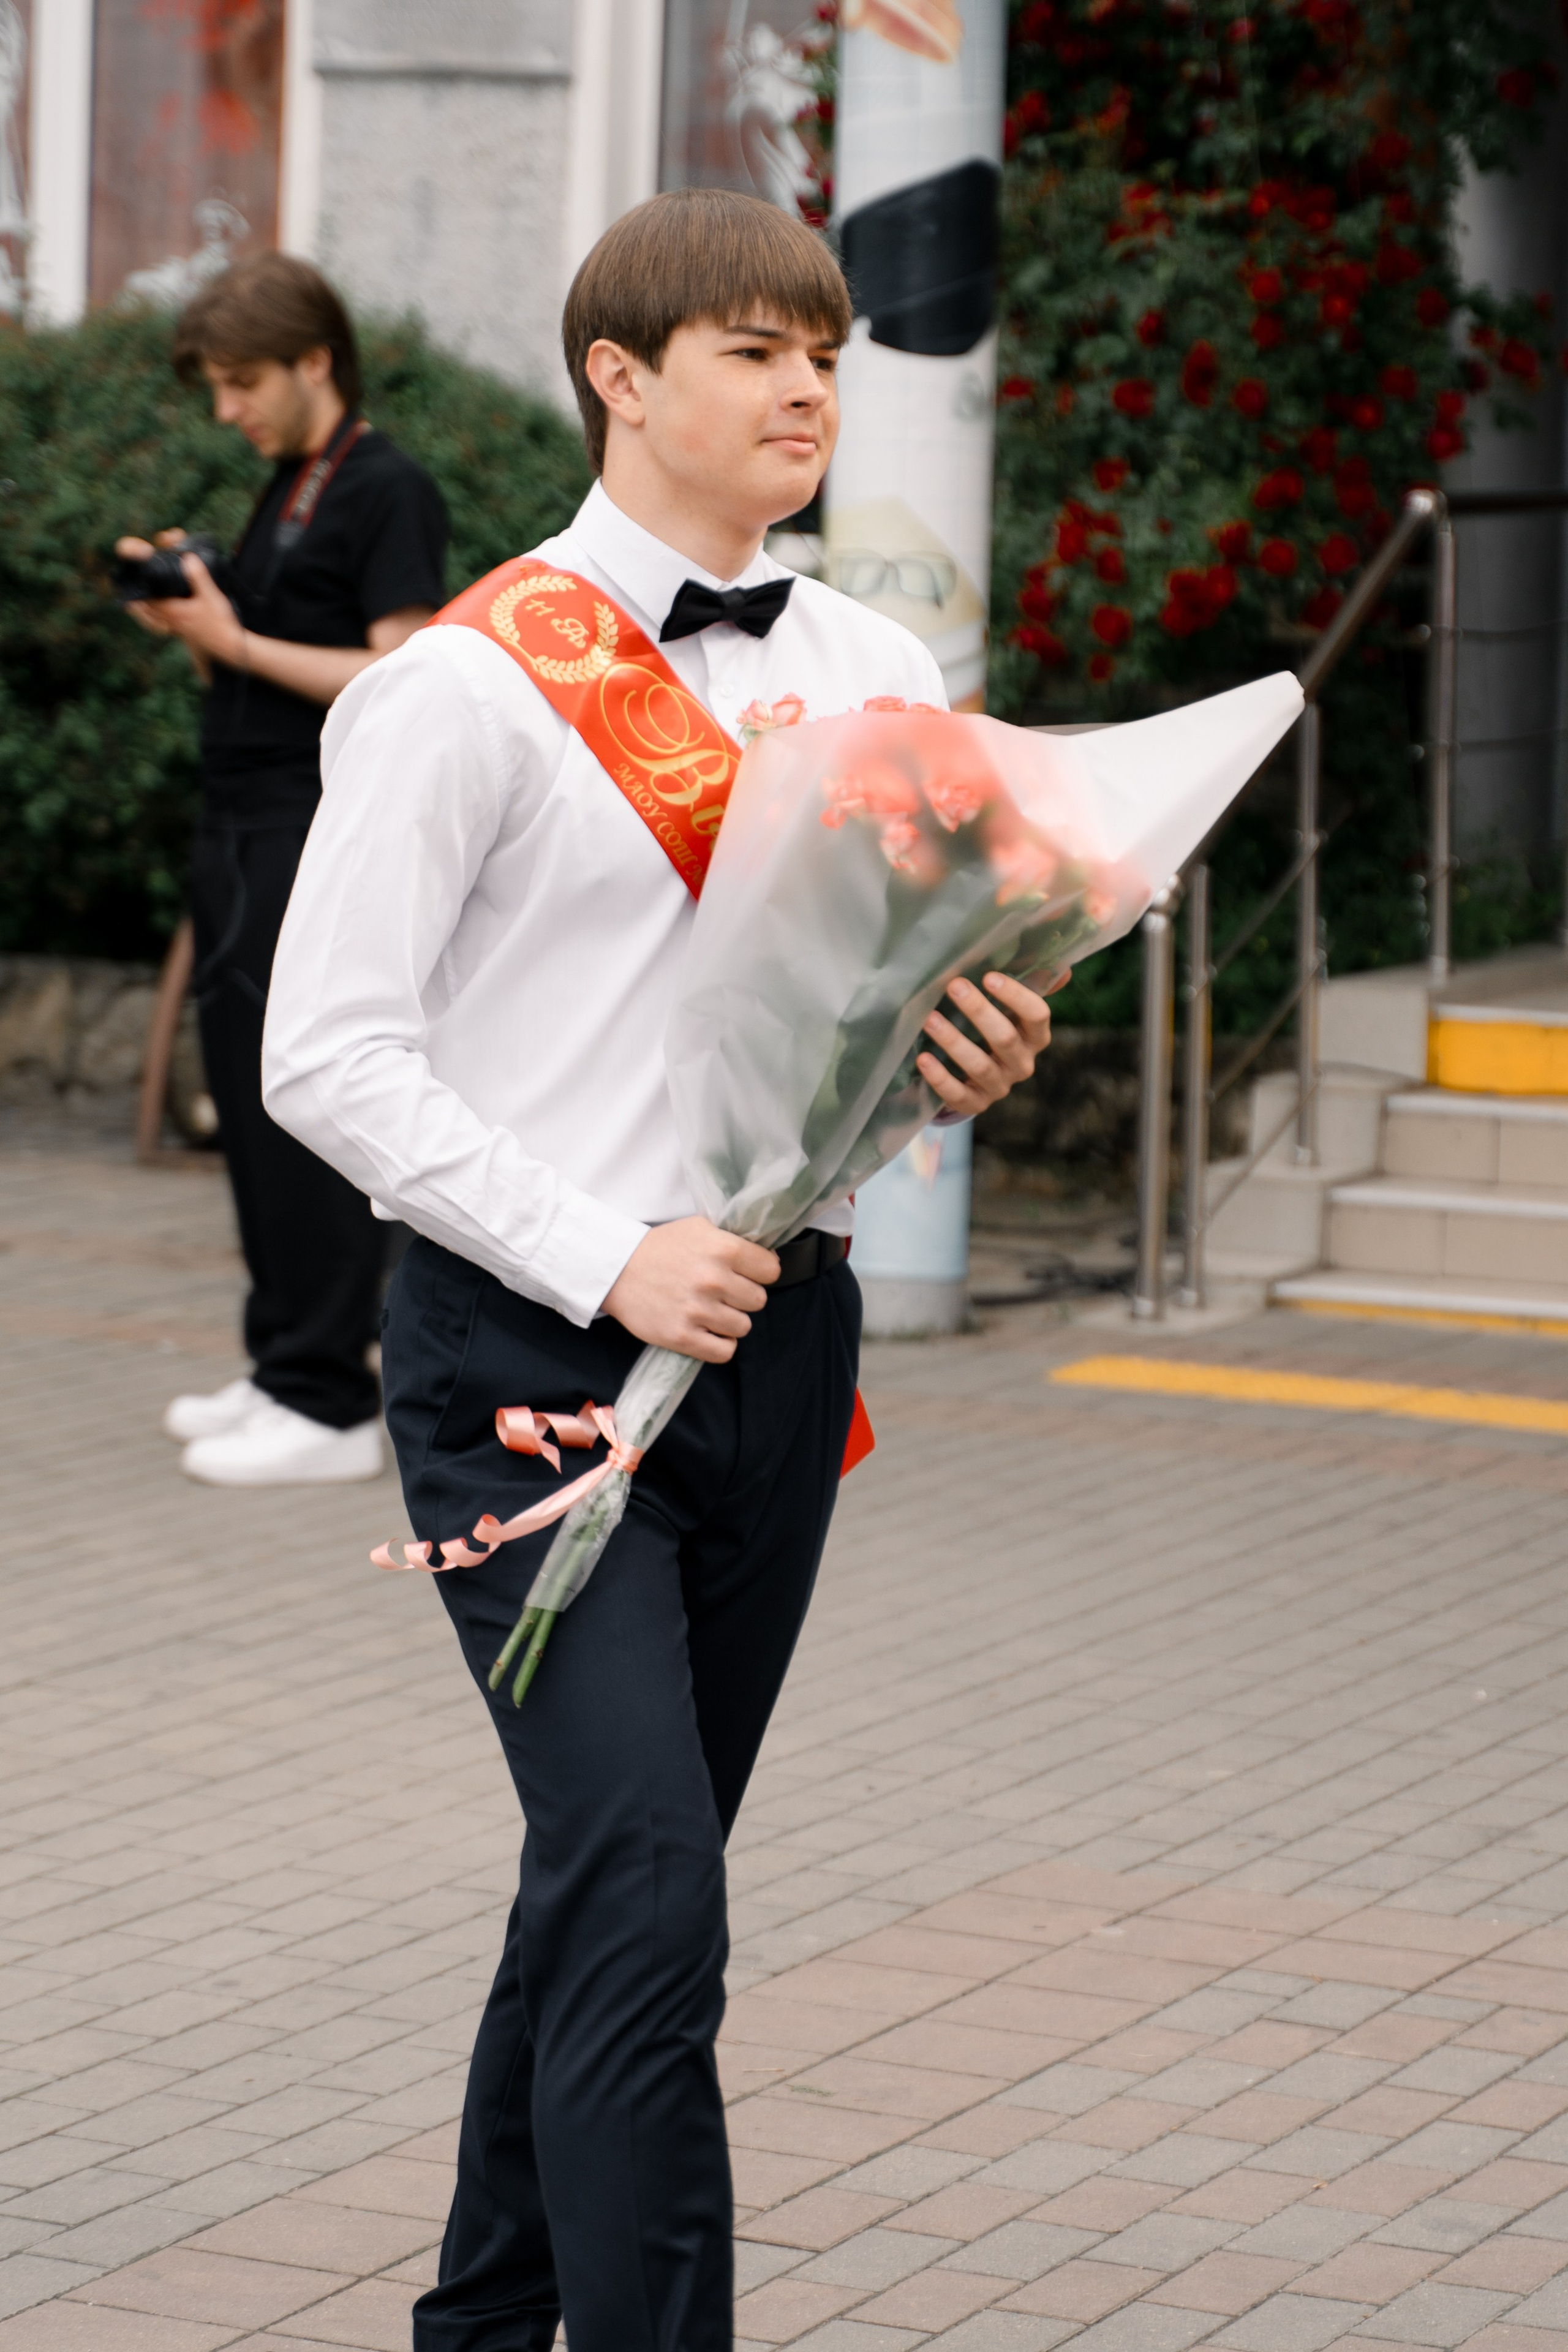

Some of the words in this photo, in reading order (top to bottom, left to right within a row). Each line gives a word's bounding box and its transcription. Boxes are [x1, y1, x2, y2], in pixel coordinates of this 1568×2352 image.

[525, 598, 556, 616] 11
[614, 763, 668, 817] МАОУ
[657, 821, 698, 867] СОШ
